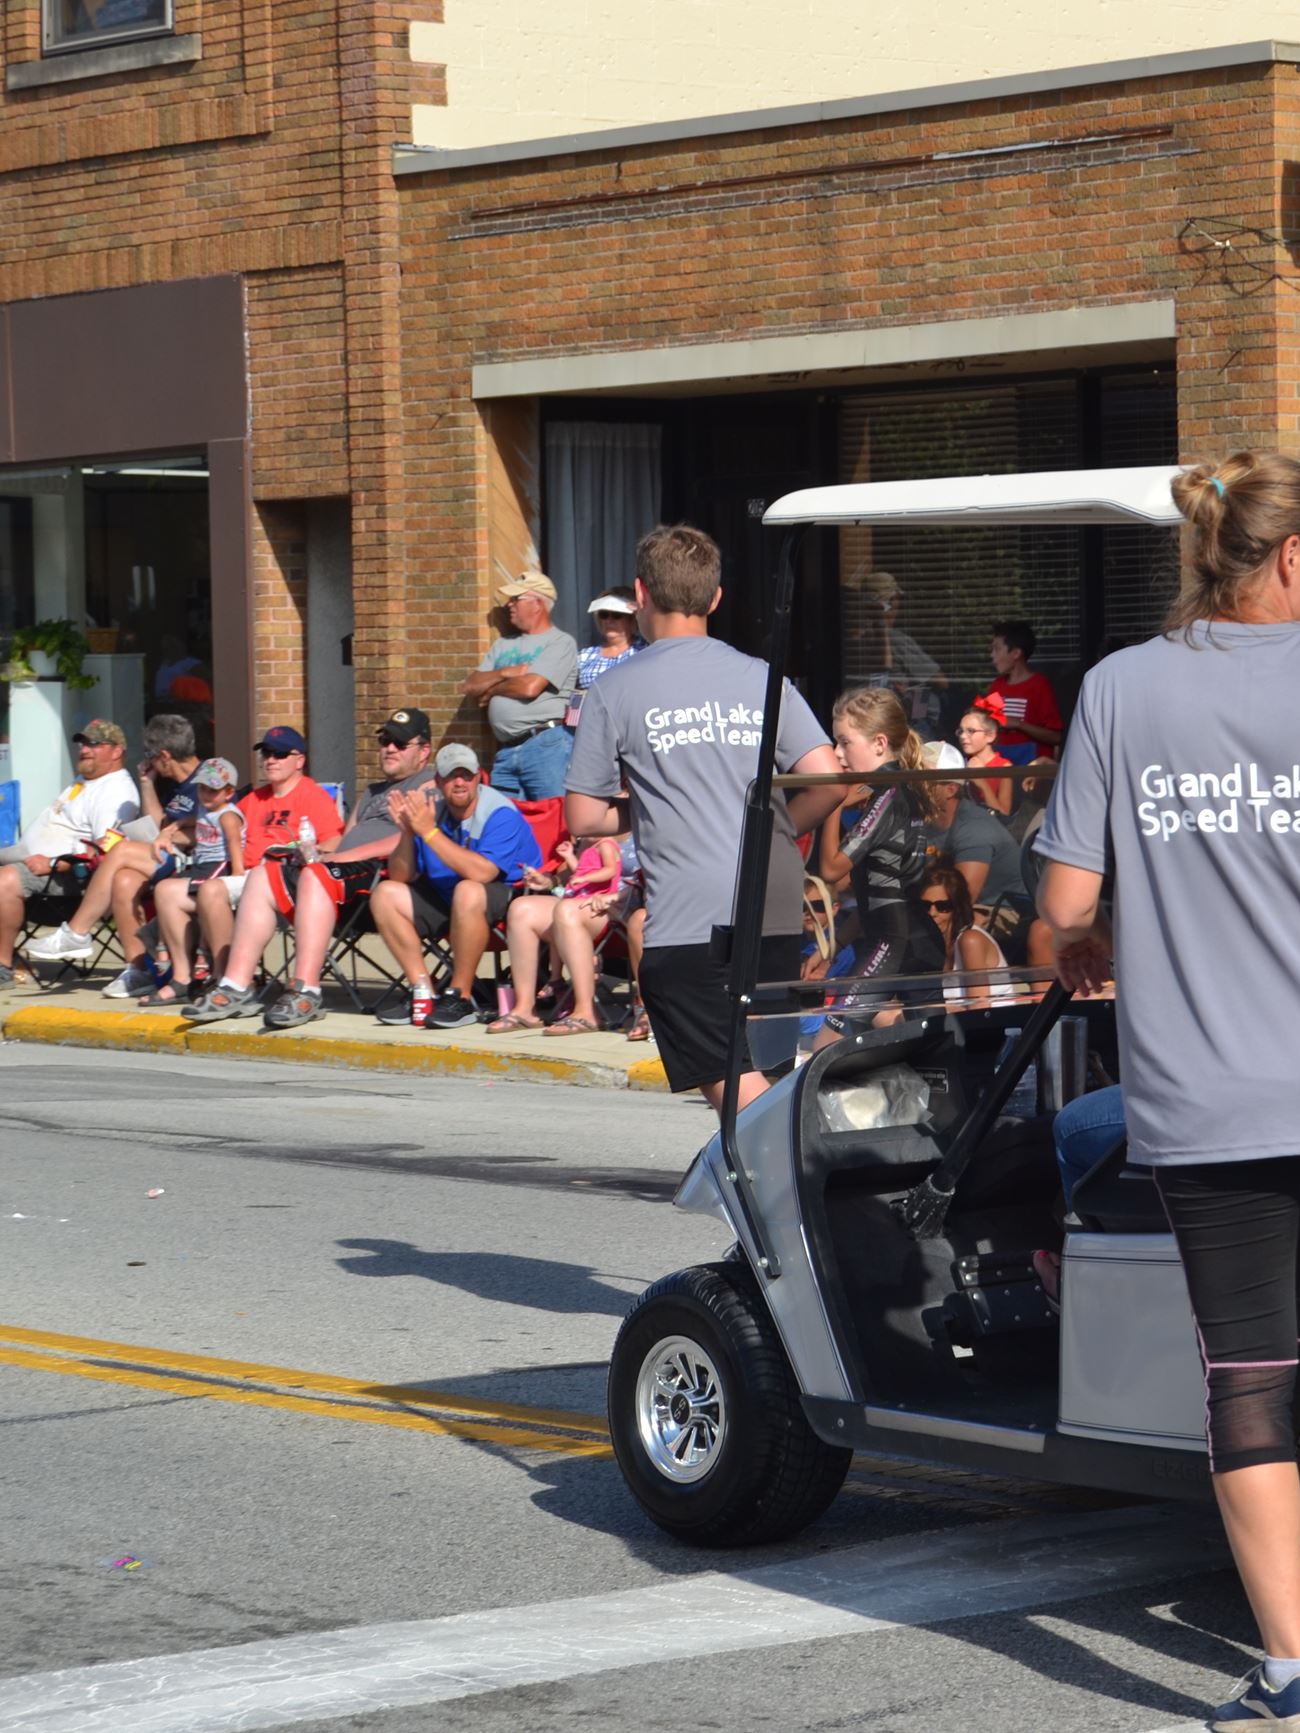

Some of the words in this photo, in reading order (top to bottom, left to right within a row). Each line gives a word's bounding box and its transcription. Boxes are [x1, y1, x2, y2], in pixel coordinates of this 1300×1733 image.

[644, 700, 713, 730] Grand
[714, 701, 764, 726] Lake
[647, 721, 716, 755] Speed
[1140, 762, 1243, 799] Grand
[1137, 799, 1240, 842] Speed
